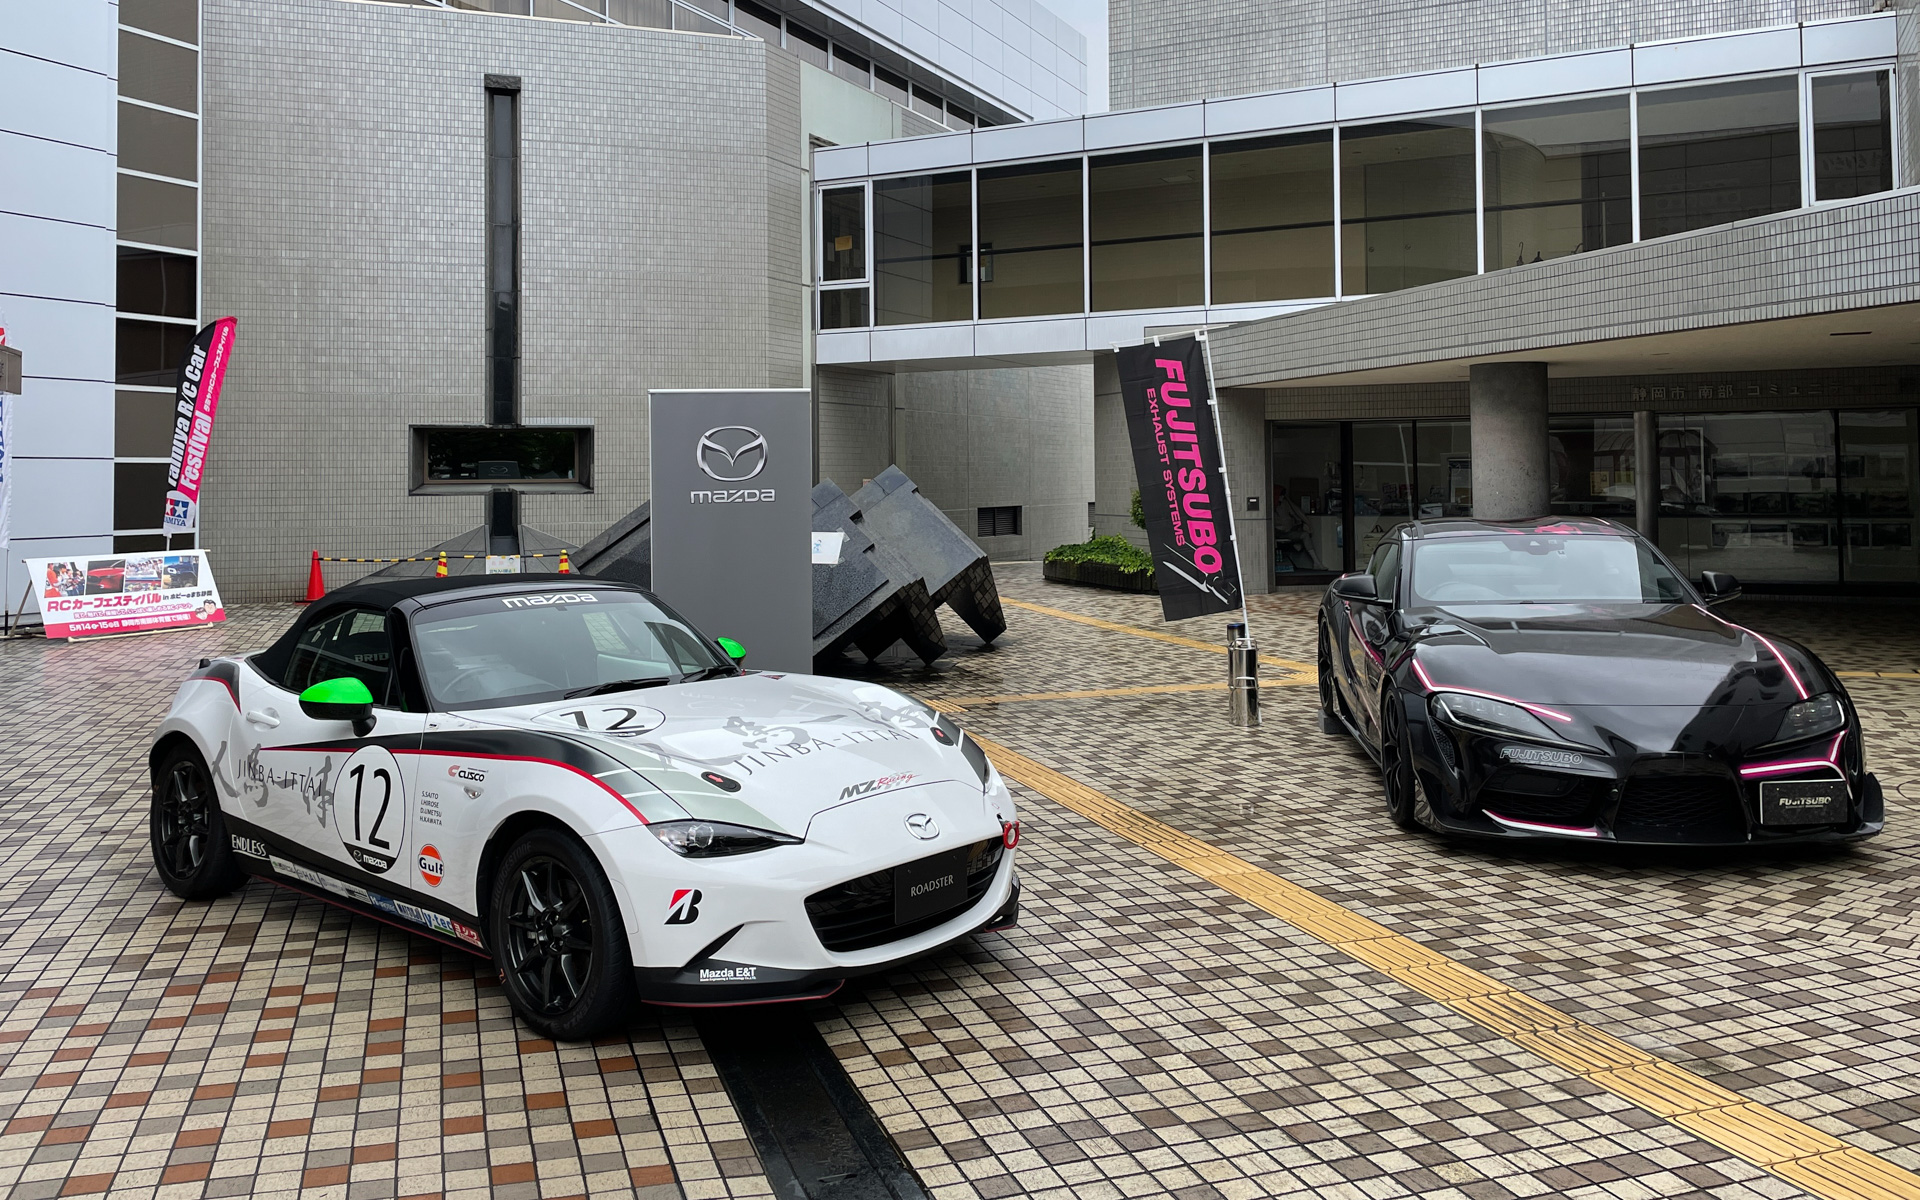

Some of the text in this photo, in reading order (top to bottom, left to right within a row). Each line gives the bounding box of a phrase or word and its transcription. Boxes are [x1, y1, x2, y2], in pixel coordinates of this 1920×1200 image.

[185, 344, 206, 381] Car
[177, 381, 197, 417] R/C
[181, 409, 212, 490] Festival
[1147, 388, 1185, 546] EXHAUST SYSTEMS
[1155, 358, 1222, 574] FUJITSUBO
[163, 516, 186, 526] AMIYA
[47, 593, 161, 612] RCカーフェスティバル
[559, 707, 645, 730] 12
[733, 728, 919, 775] JINBA-ITTAI
[1499, 747, 1583, 765] FUJITSUBO
[237, 759, 322, 796] JINBA-ITTAI
[349, 763, 392, 850] 12
[1779, 796, 1832, 806] FUJITSUBO
[231, 834, 266, 858] ENDLESS
[419, 857, 444, 875] Gulf
[910, 874, 954, 897] ROADSTER
[700, 968, 734, 979] Mazda
[736, 966, 757, 977] E&T
